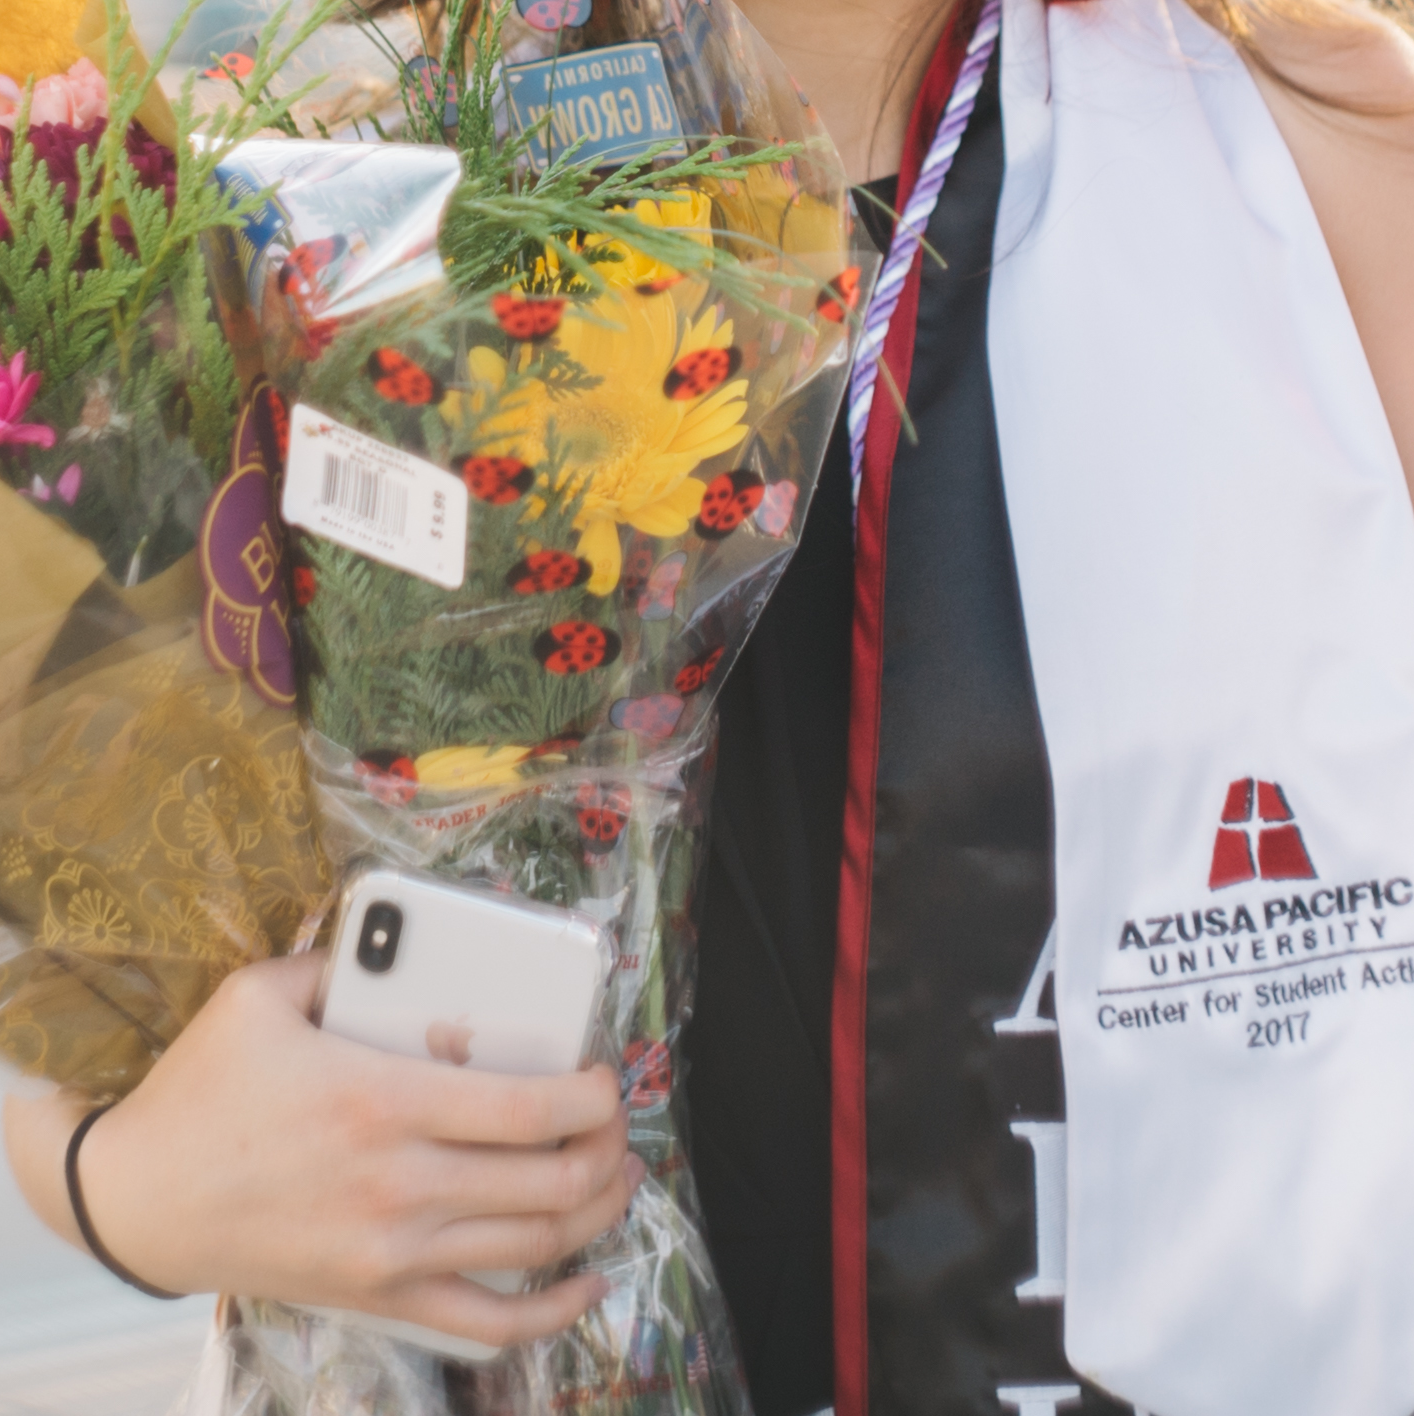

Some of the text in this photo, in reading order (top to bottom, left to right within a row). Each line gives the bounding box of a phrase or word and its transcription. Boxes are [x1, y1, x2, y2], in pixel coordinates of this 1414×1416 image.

[412, 803, 487, 831] TRADER
[1117, 876, 1414, 951] AZUSA PACIFIC
[1149, 916, 1389, 976] UNIVERSITY
[1097, 988, 1189, 1032] Center
[1203, 987, 1243, 1016] for
[1255, 966, 1348, 1009] Student
[1246, 1011, 1312, 1049] 2017
